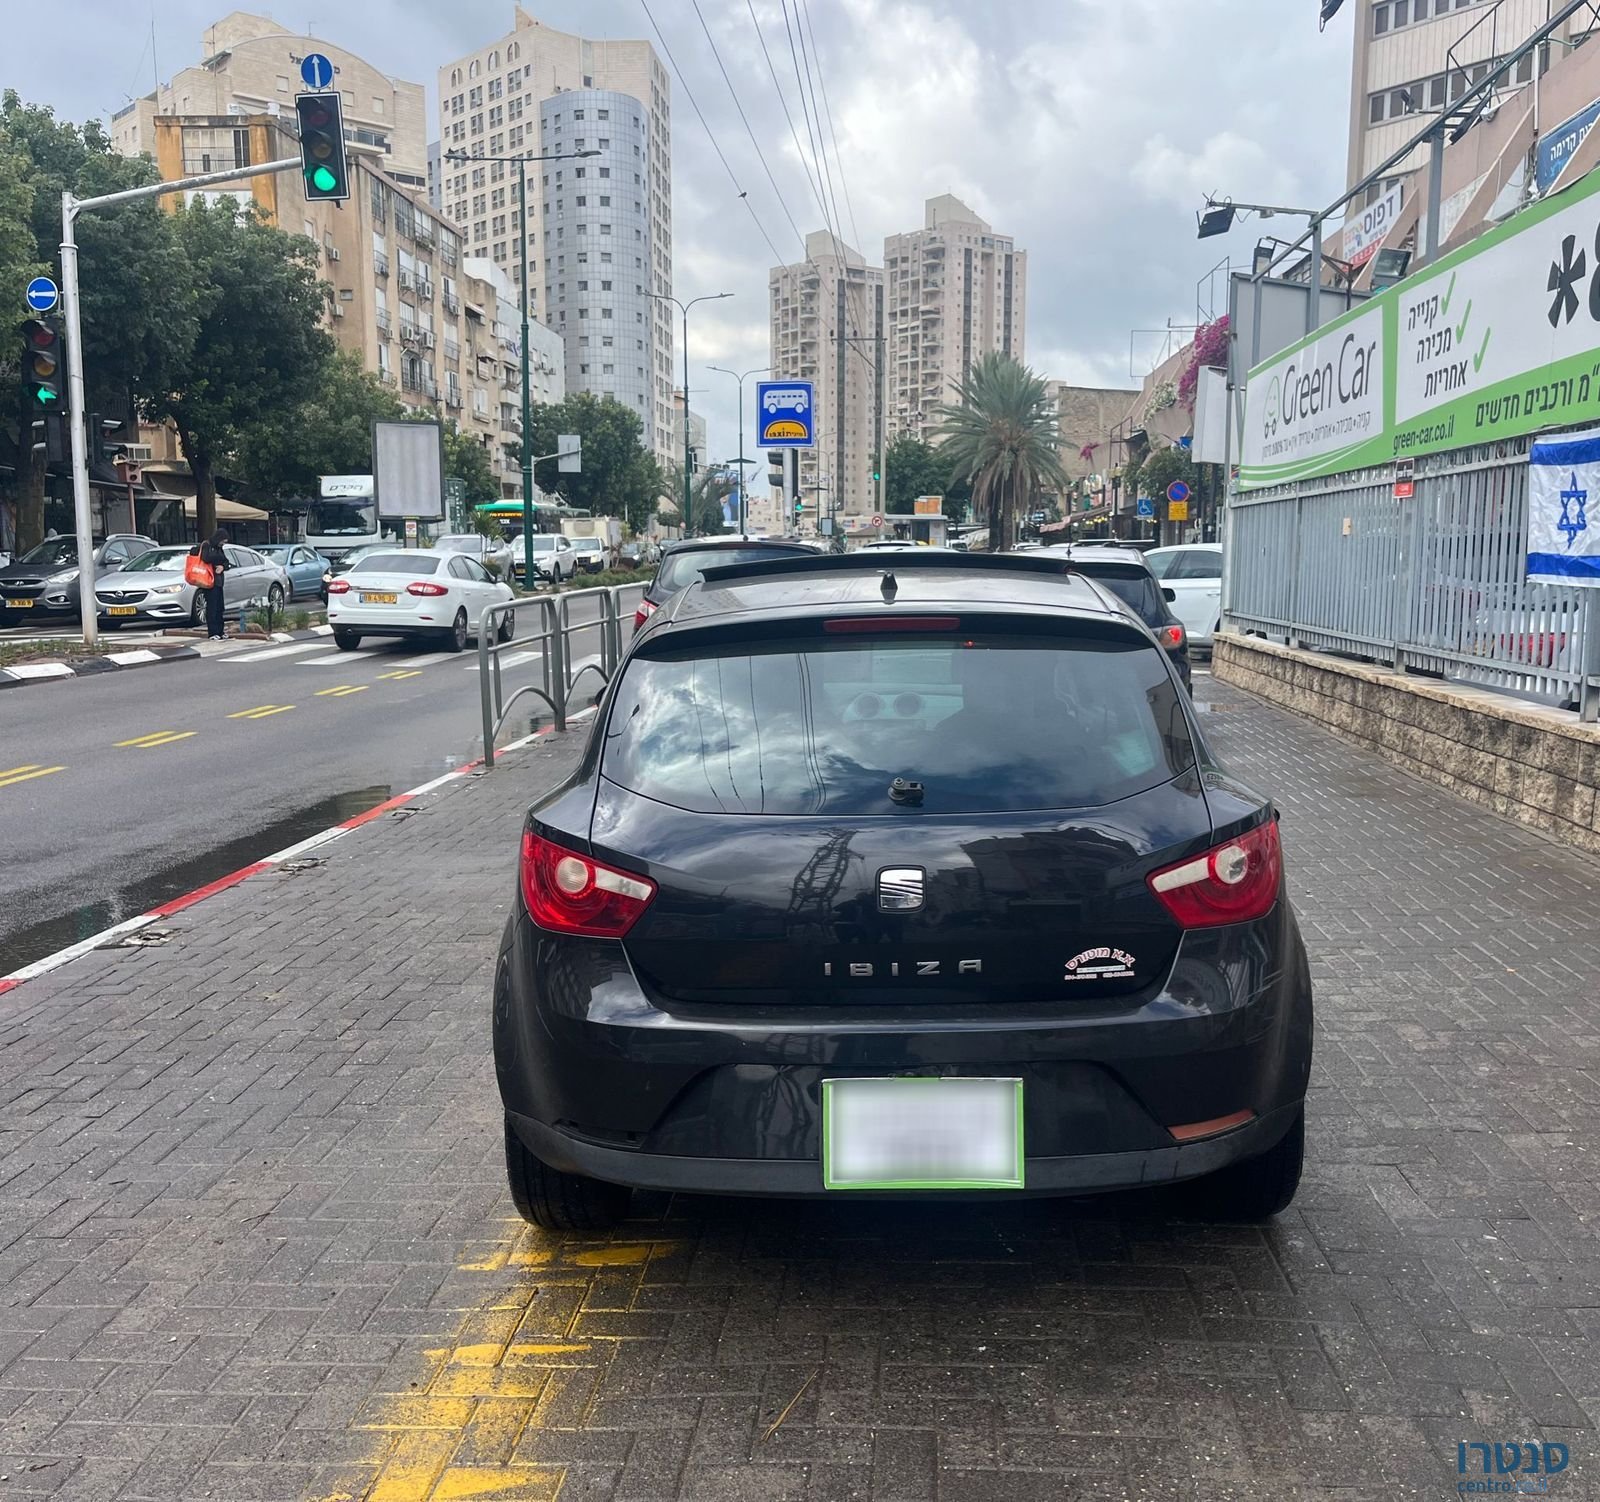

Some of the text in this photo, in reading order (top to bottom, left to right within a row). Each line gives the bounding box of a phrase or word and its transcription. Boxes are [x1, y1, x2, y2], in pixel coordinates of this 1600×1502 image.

[1550, 132, 1577, 161] קדימה
[1363, 194, 1395, 235] דפוס
[1407, 294, 1439, 332] קנייה
[1416, 326, 1452, 364] מכירה
[1282, 333, 1377, 426] Green Car
[1424, 359, 1469, 399] אחריות
[1523, 378, 1575, 416] ורכבים
[1475, 393, 1520, 428] חדשים
[1393, 414, 1455, 456] green-car.co.il
[824, 958, 983, 977] IBIZA
[1064, 947, 1110, 970] מוטורס
